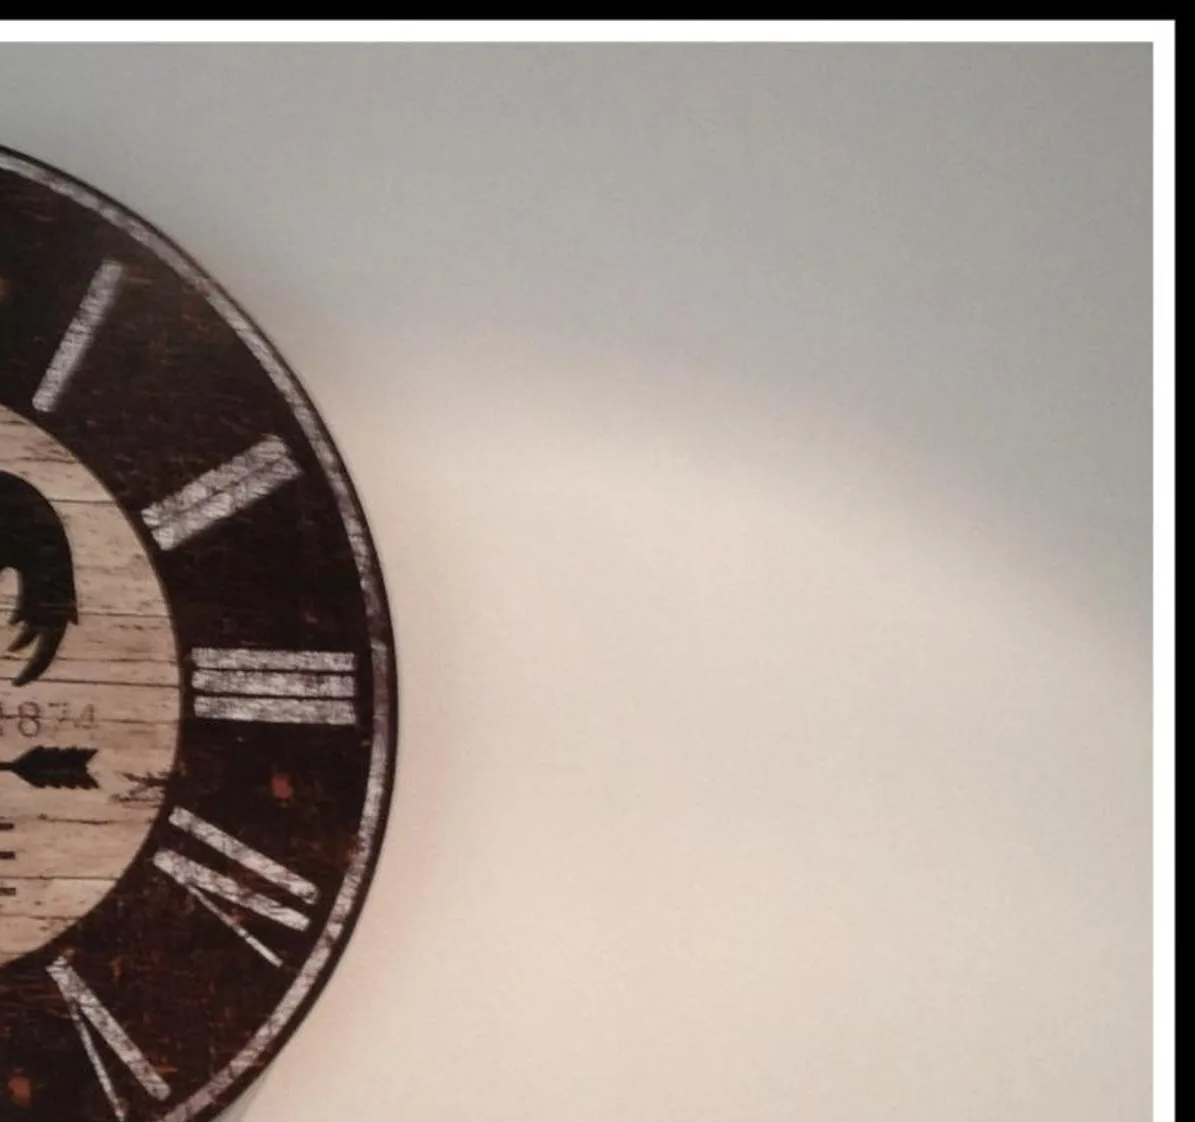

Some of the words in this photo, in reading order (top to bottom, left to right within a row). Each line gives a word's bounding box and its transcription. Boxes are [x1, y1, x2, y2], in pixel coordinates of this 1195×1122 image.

[142, 435, 302, 551] II
[191, 648, 358, 725] III
[152, 806, 319, 968] IV
[47, 956, 171, 1122] V
